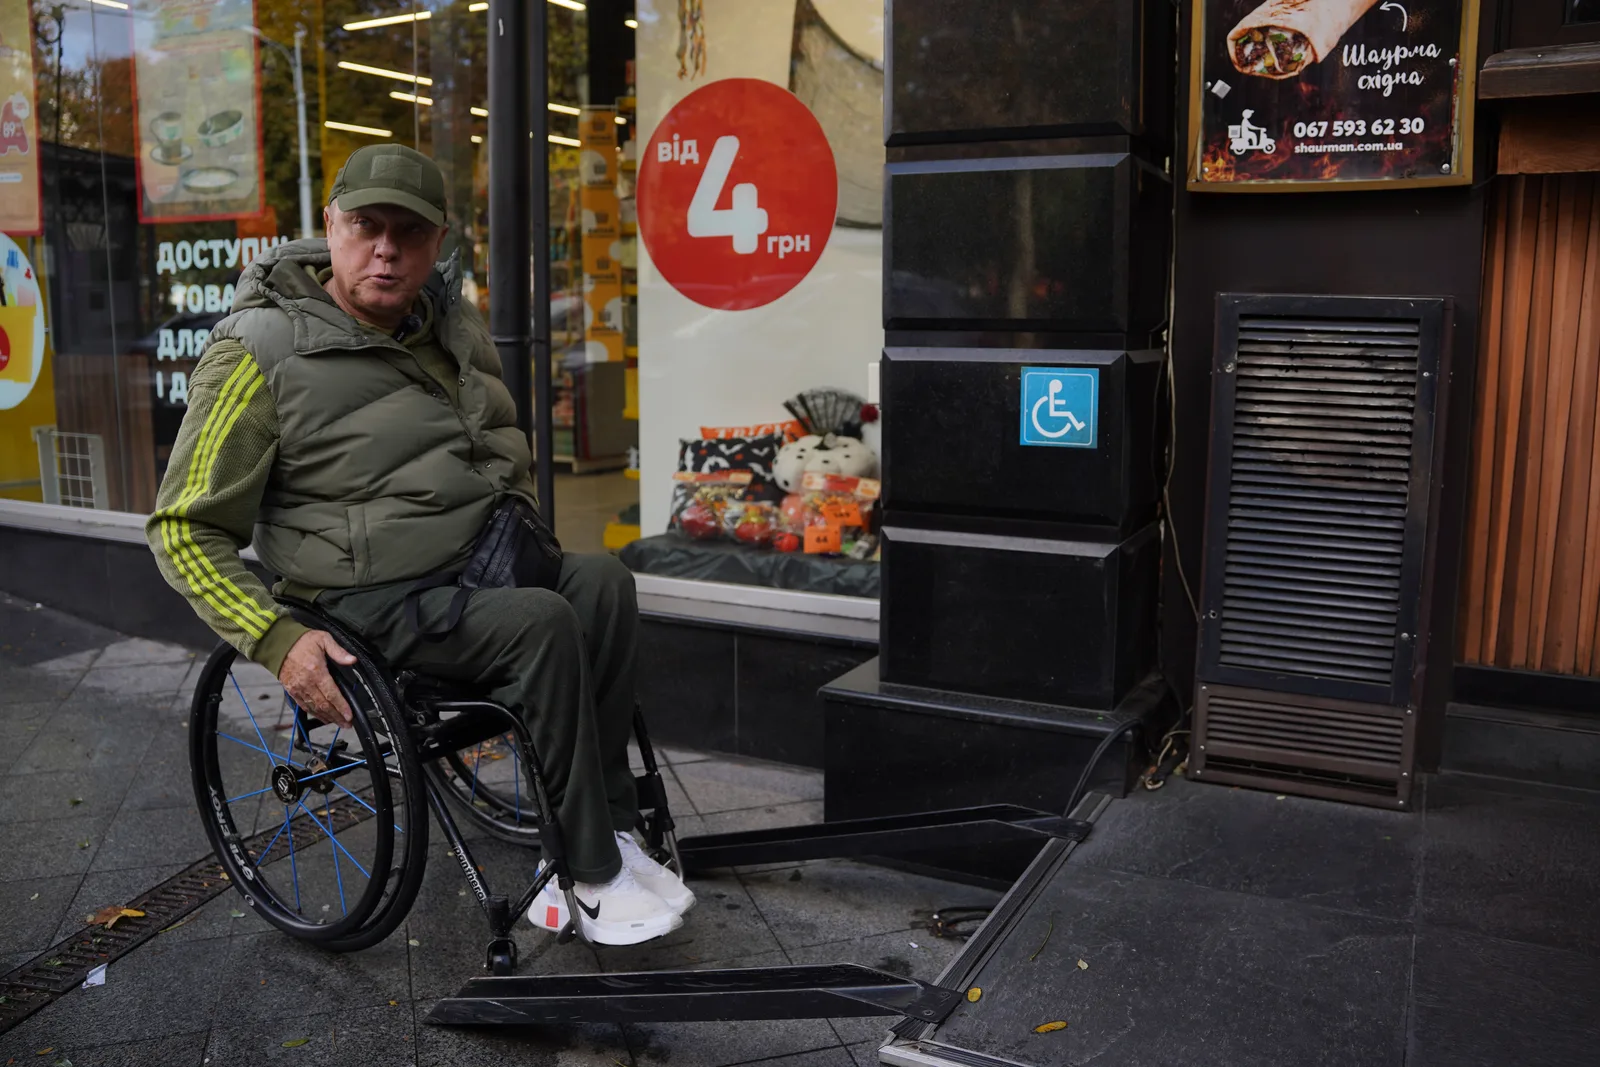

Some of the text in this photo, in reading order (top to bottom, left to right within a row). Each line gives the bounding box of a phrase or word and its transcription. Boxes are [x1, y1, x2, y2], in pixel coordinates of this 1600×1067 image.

[1342, 43, 1442, 71] Шаурма
[1357, 70, 1424, 97] східна
[1293, 117, 1425, 138] 067 593 62 30
[1294, 141, 1403, 154] shaurman.com.ua
[657, 133, 811, 259] від 4 грн
[156, 234, 288, 275] ДОСТУП
[157, 329, 210, 362] ДЛЯ
[453, 844, 488, 902] panthera
